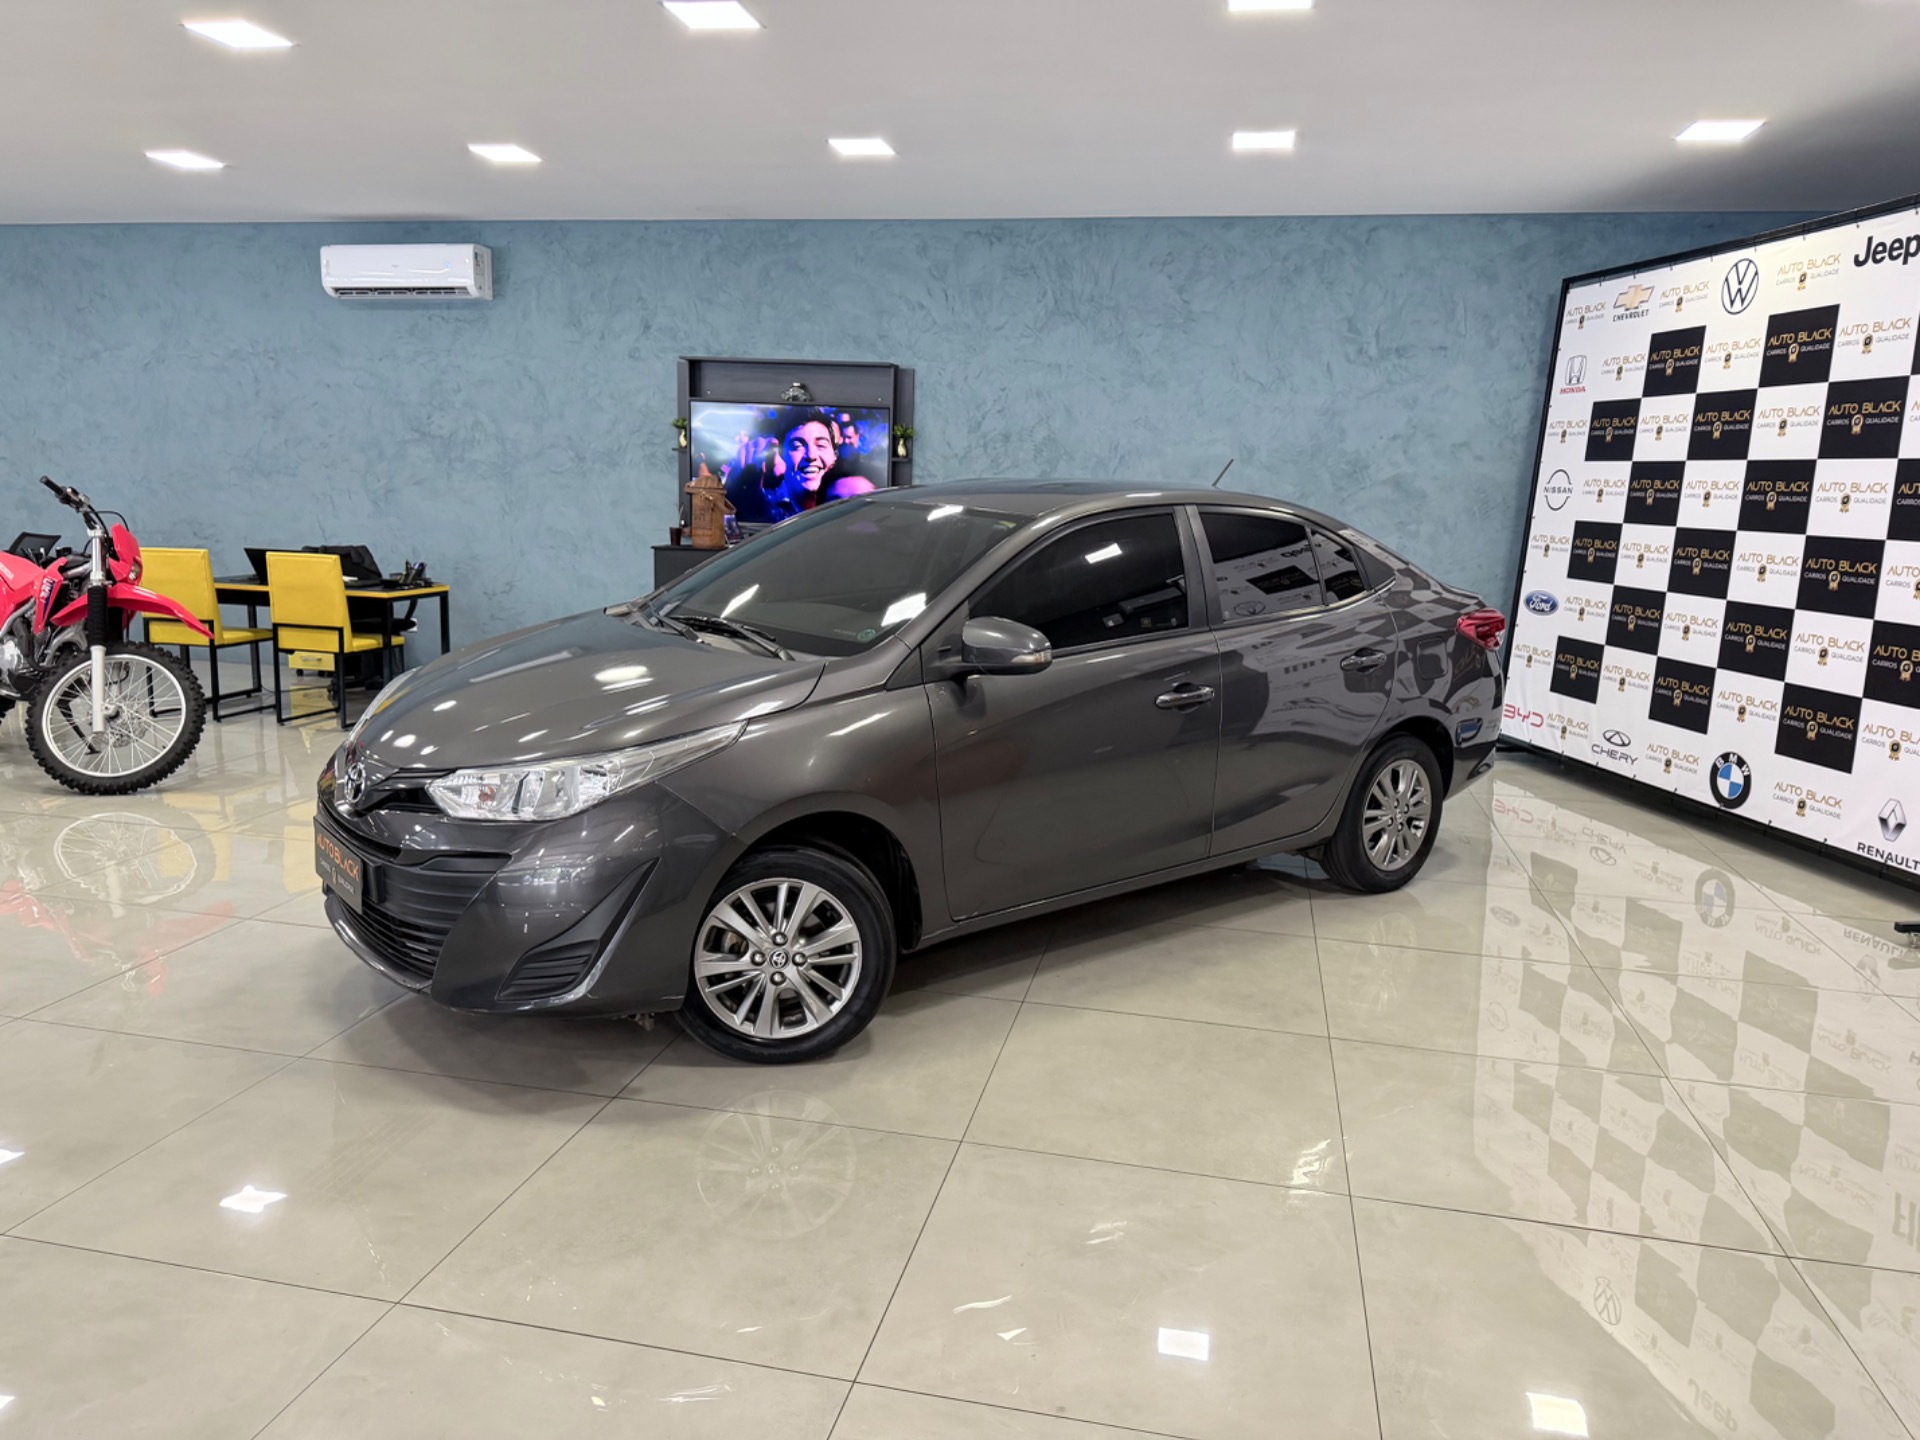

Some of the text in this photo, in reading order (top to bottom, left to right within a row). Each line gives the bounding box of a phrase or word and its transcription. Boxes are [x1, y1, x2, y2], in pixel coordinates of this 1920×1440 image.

[1854, 234, 1920, 267] Jeep
[1778, 253, 1841, 275] AUTO BLACK
[1612, 309, 1649, 322] CHEVROLET
[1839, 317, 1912, 337] AUTO BLACK
[1768, 328, 1832, 346] AUTO BLACK
[1706, 338, 1761, 354] AUTO BLACK
[1560, 386, 1586, 394] HONDA
[1758, 405, 1821, 419] AUTO BLACK
[1828, 403, 1858, 415] AUTO
[1861, 400, 1902, 413] BLACK
[1695, 410, 1751, 422] AUTO BLACK
[1544, 486, 1573, 494] NISSAN
[1685, 480, 1740, 490] AUTO BLACK
[1746, 480, 1809, 492] AUTO BLACK
[1817, 482, 1888, 493] AUTO BLACK
[1898, 482, 1920, 494] AUT
[1675, 547, 1730, 560] AUTO BLACK
[1738, 553, 1799, 566] AUTO BLACK
[1806, 558, 1877, 574] AUTO BLACK
[1887, 565, 1920, 578] AUTO
[1530, 593, 1553, 611] Ford
[1665, 613, 1687, 623] AUTO
[1689, 615, 1718, 628] BLACK
[1726, 622, 1787, 640] AUTO BLACK
[1796, 633, 1865, 652] AUTO BLACK
[1874, 644, 1908, 660] AUTO
[1872, 658, 1898, 670] CARROS
[1657, 677, 1679, 688] AUTO
[1680, 681, 1710, 696] BLACK
[1717, 691, 1778, 712] AUTO BLACK
[1503, 704, 1544, 728] BYD
[1785, 706, 1854, 730] AUTO BLACK
[1863, 724, 1896, 740] AUTO
[1591, 744, 1638, 766] CHERY
[1647, 743, 1699, 766] AUTO BLACK
[1715, 753, 1750, 776] BMW
[1774, 781, 1843, 810] AUTO BLACK
[1857, 842, 1920, 870] RENAULT
